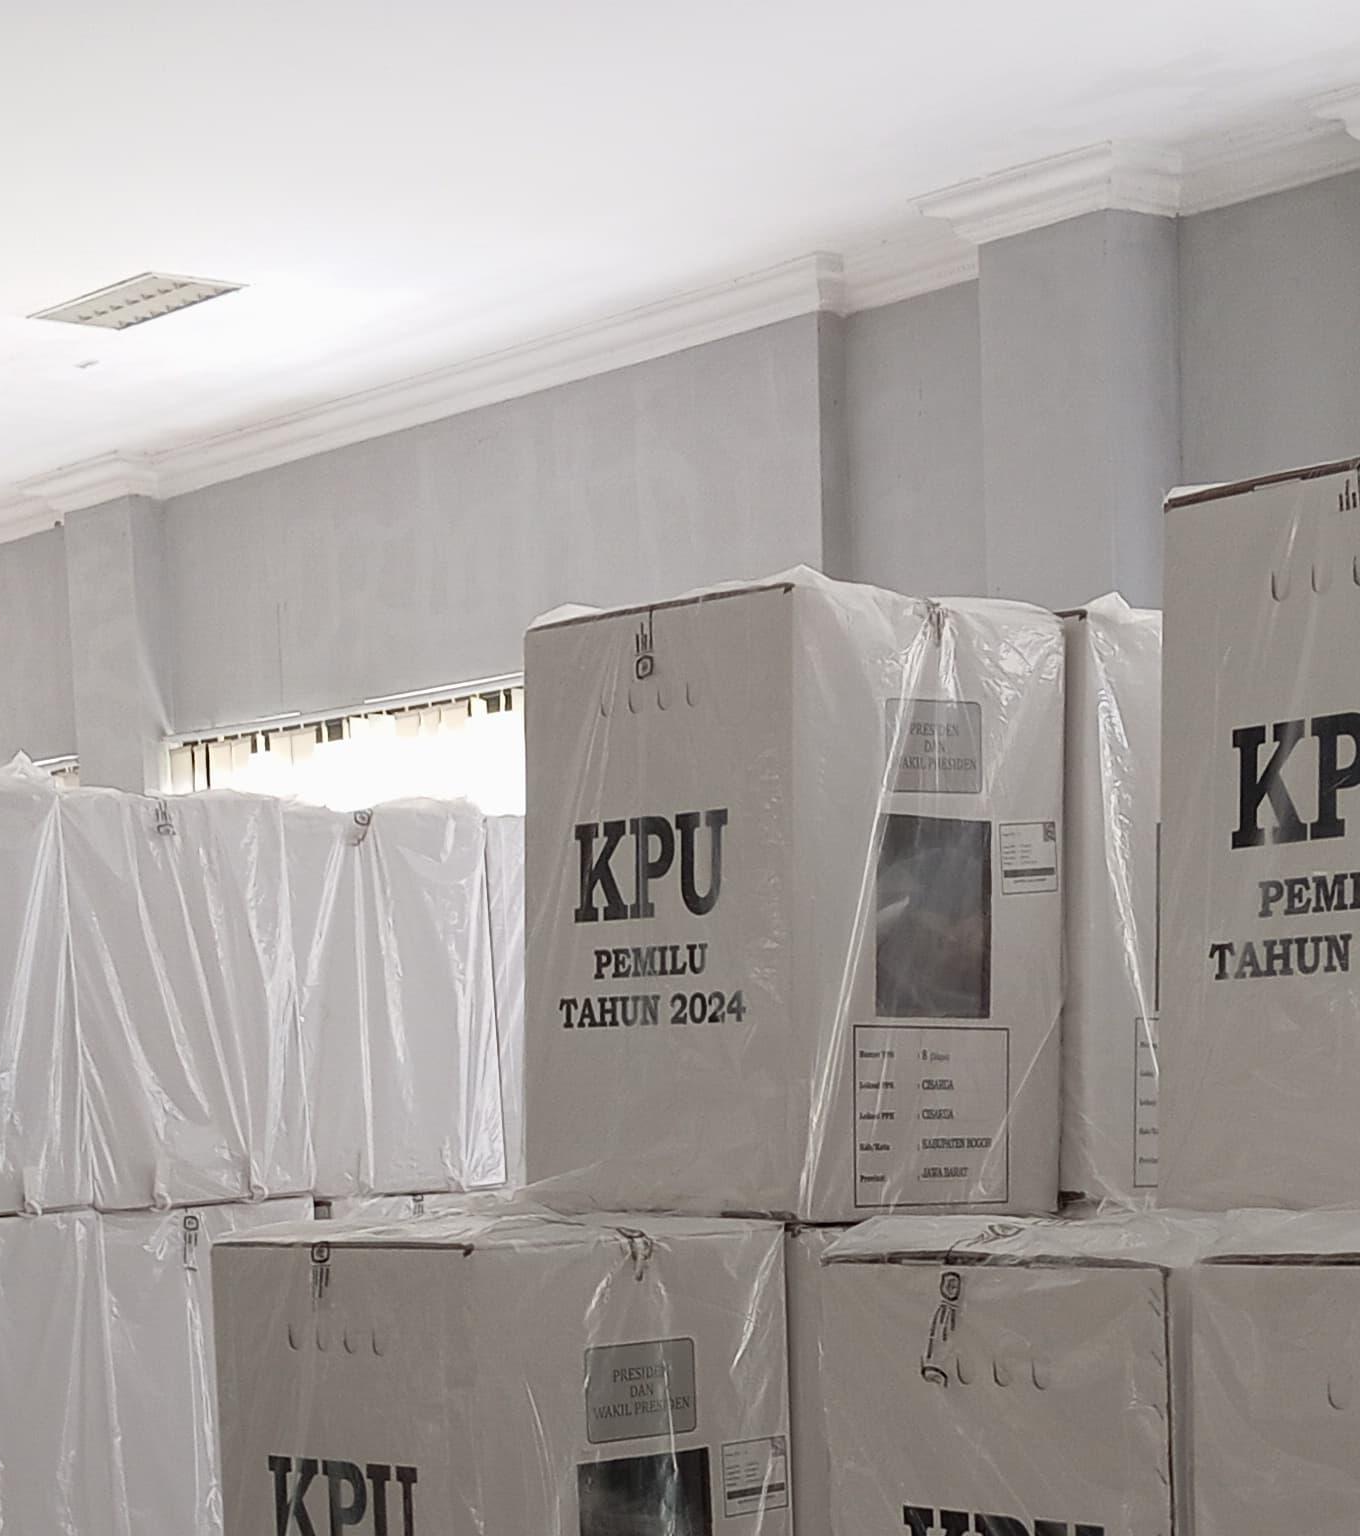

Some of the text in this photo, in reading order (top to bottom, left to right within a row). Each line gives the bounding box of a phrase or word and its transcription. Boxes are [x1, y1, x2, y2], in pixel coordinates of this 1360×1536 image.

[910, 722, 959, 737] PRESDEN
[574, 808, 728, 924] KPU
[594, 943, 708, 980] PEMILU
[1209, 934, 1351, 981] TAHUN
[560, 991, 746, 1029] TAHUN 2024
[594, 1396, 690, 1420] WAKIL PRESDEN
[630, 1384, 654, 1398] DAN
